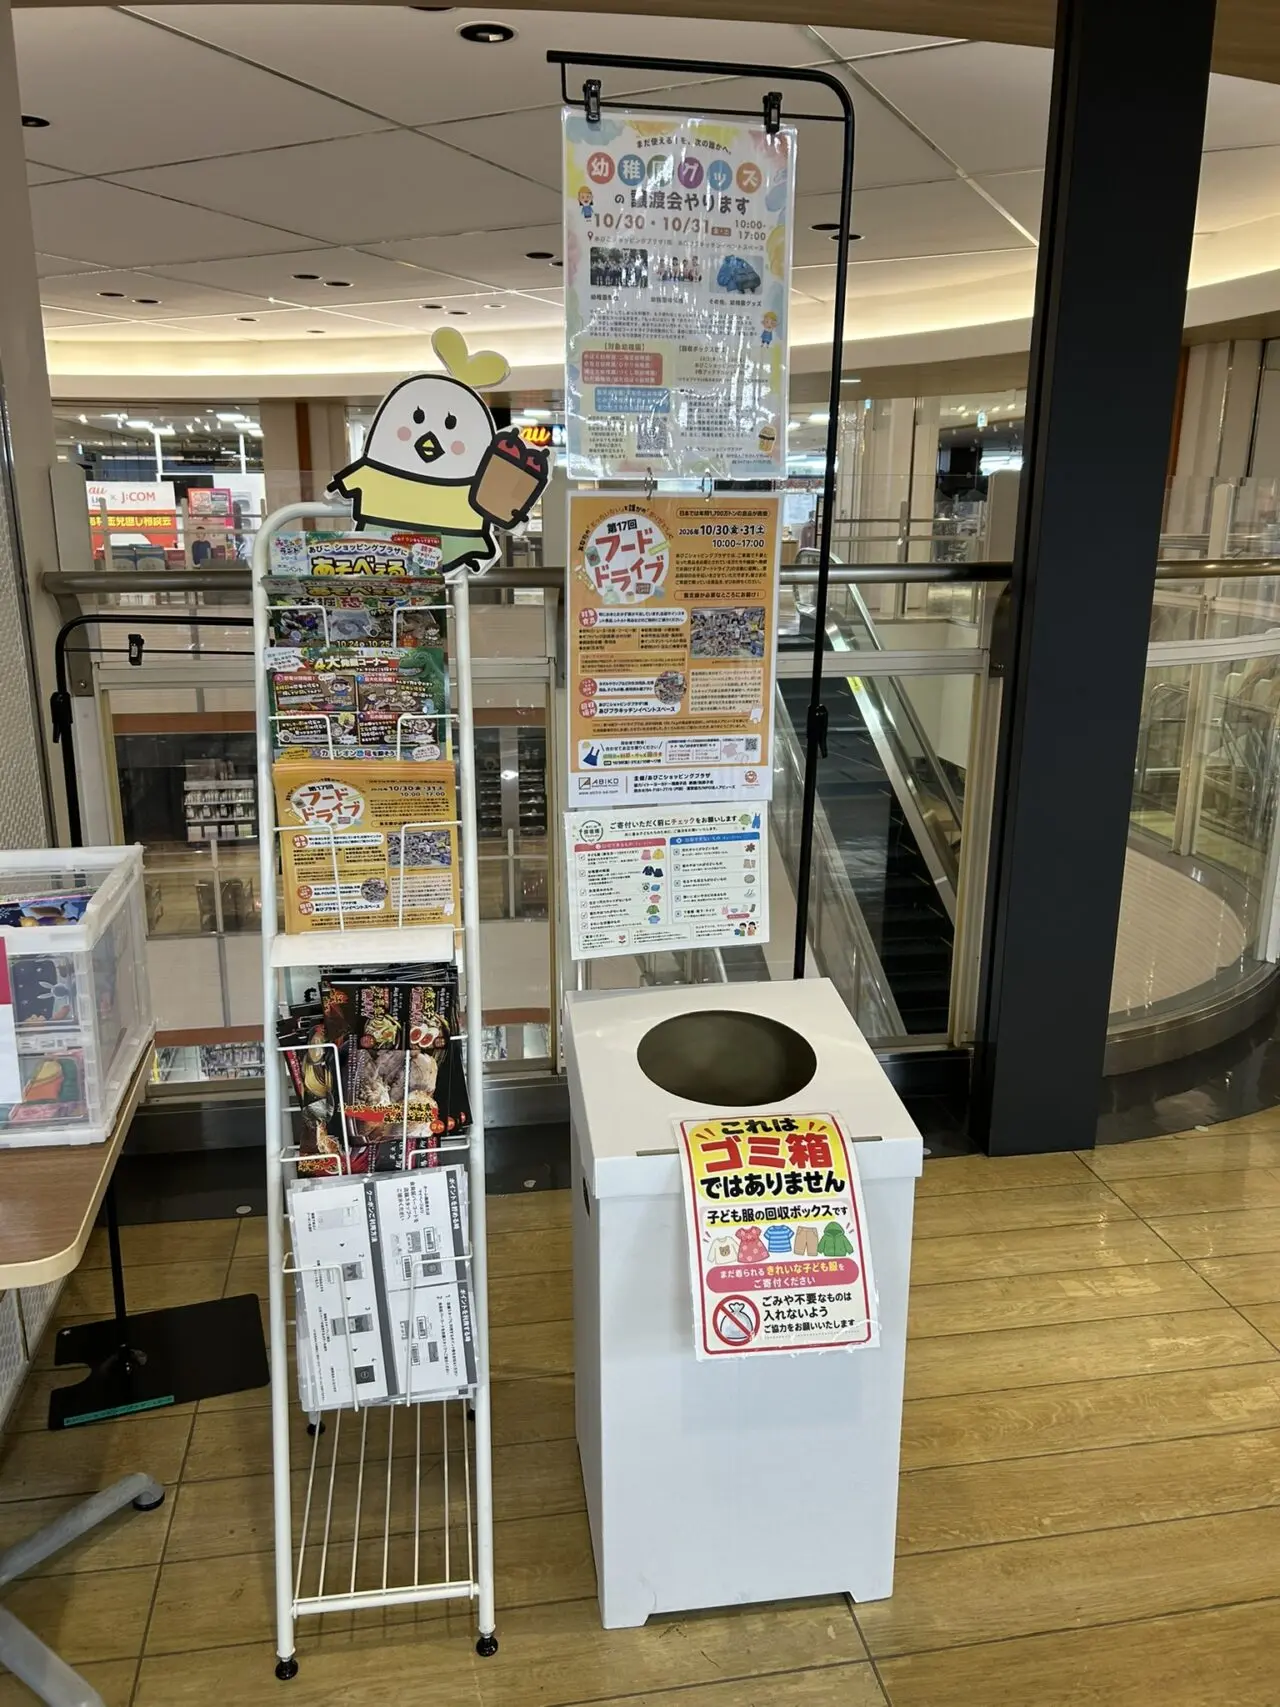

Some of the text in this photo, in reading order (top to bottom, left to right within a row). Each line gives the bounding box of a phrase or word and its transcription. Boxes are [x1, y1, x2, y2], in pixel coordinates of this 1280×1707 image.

[520, 426, 551, 443] au
[88, 486, 107, 495] au
[606, 518, 638, 534] 第17回
[595, 527, 653, 563] フード
[594, 554, 665, 593] ドライブ
[591, 777, 620, 785] ABIKO
[300, 788, 349, 806] フード
[302, 801, 361, 823] ドライブ
[609, 815, 738, 830] ご寄付いただく前にチェックをお願いします
[721, 1118, 799, 1134] これは
[701, 1132, 833, 1173] ゴミ箱
[700, 1170, 846, 1199] ではありません
[707, 1204, 848, 1224] 子ども服の回収ボックスです
[753, 1276, 816, 1289] ご寄付ください
[762, 1292, 852, 1307] ごみや不要なものは
[763, 1307, 829, 1322] 入れないよう
[763, 1318, 855, 1334] ご協力をお願いいたします
